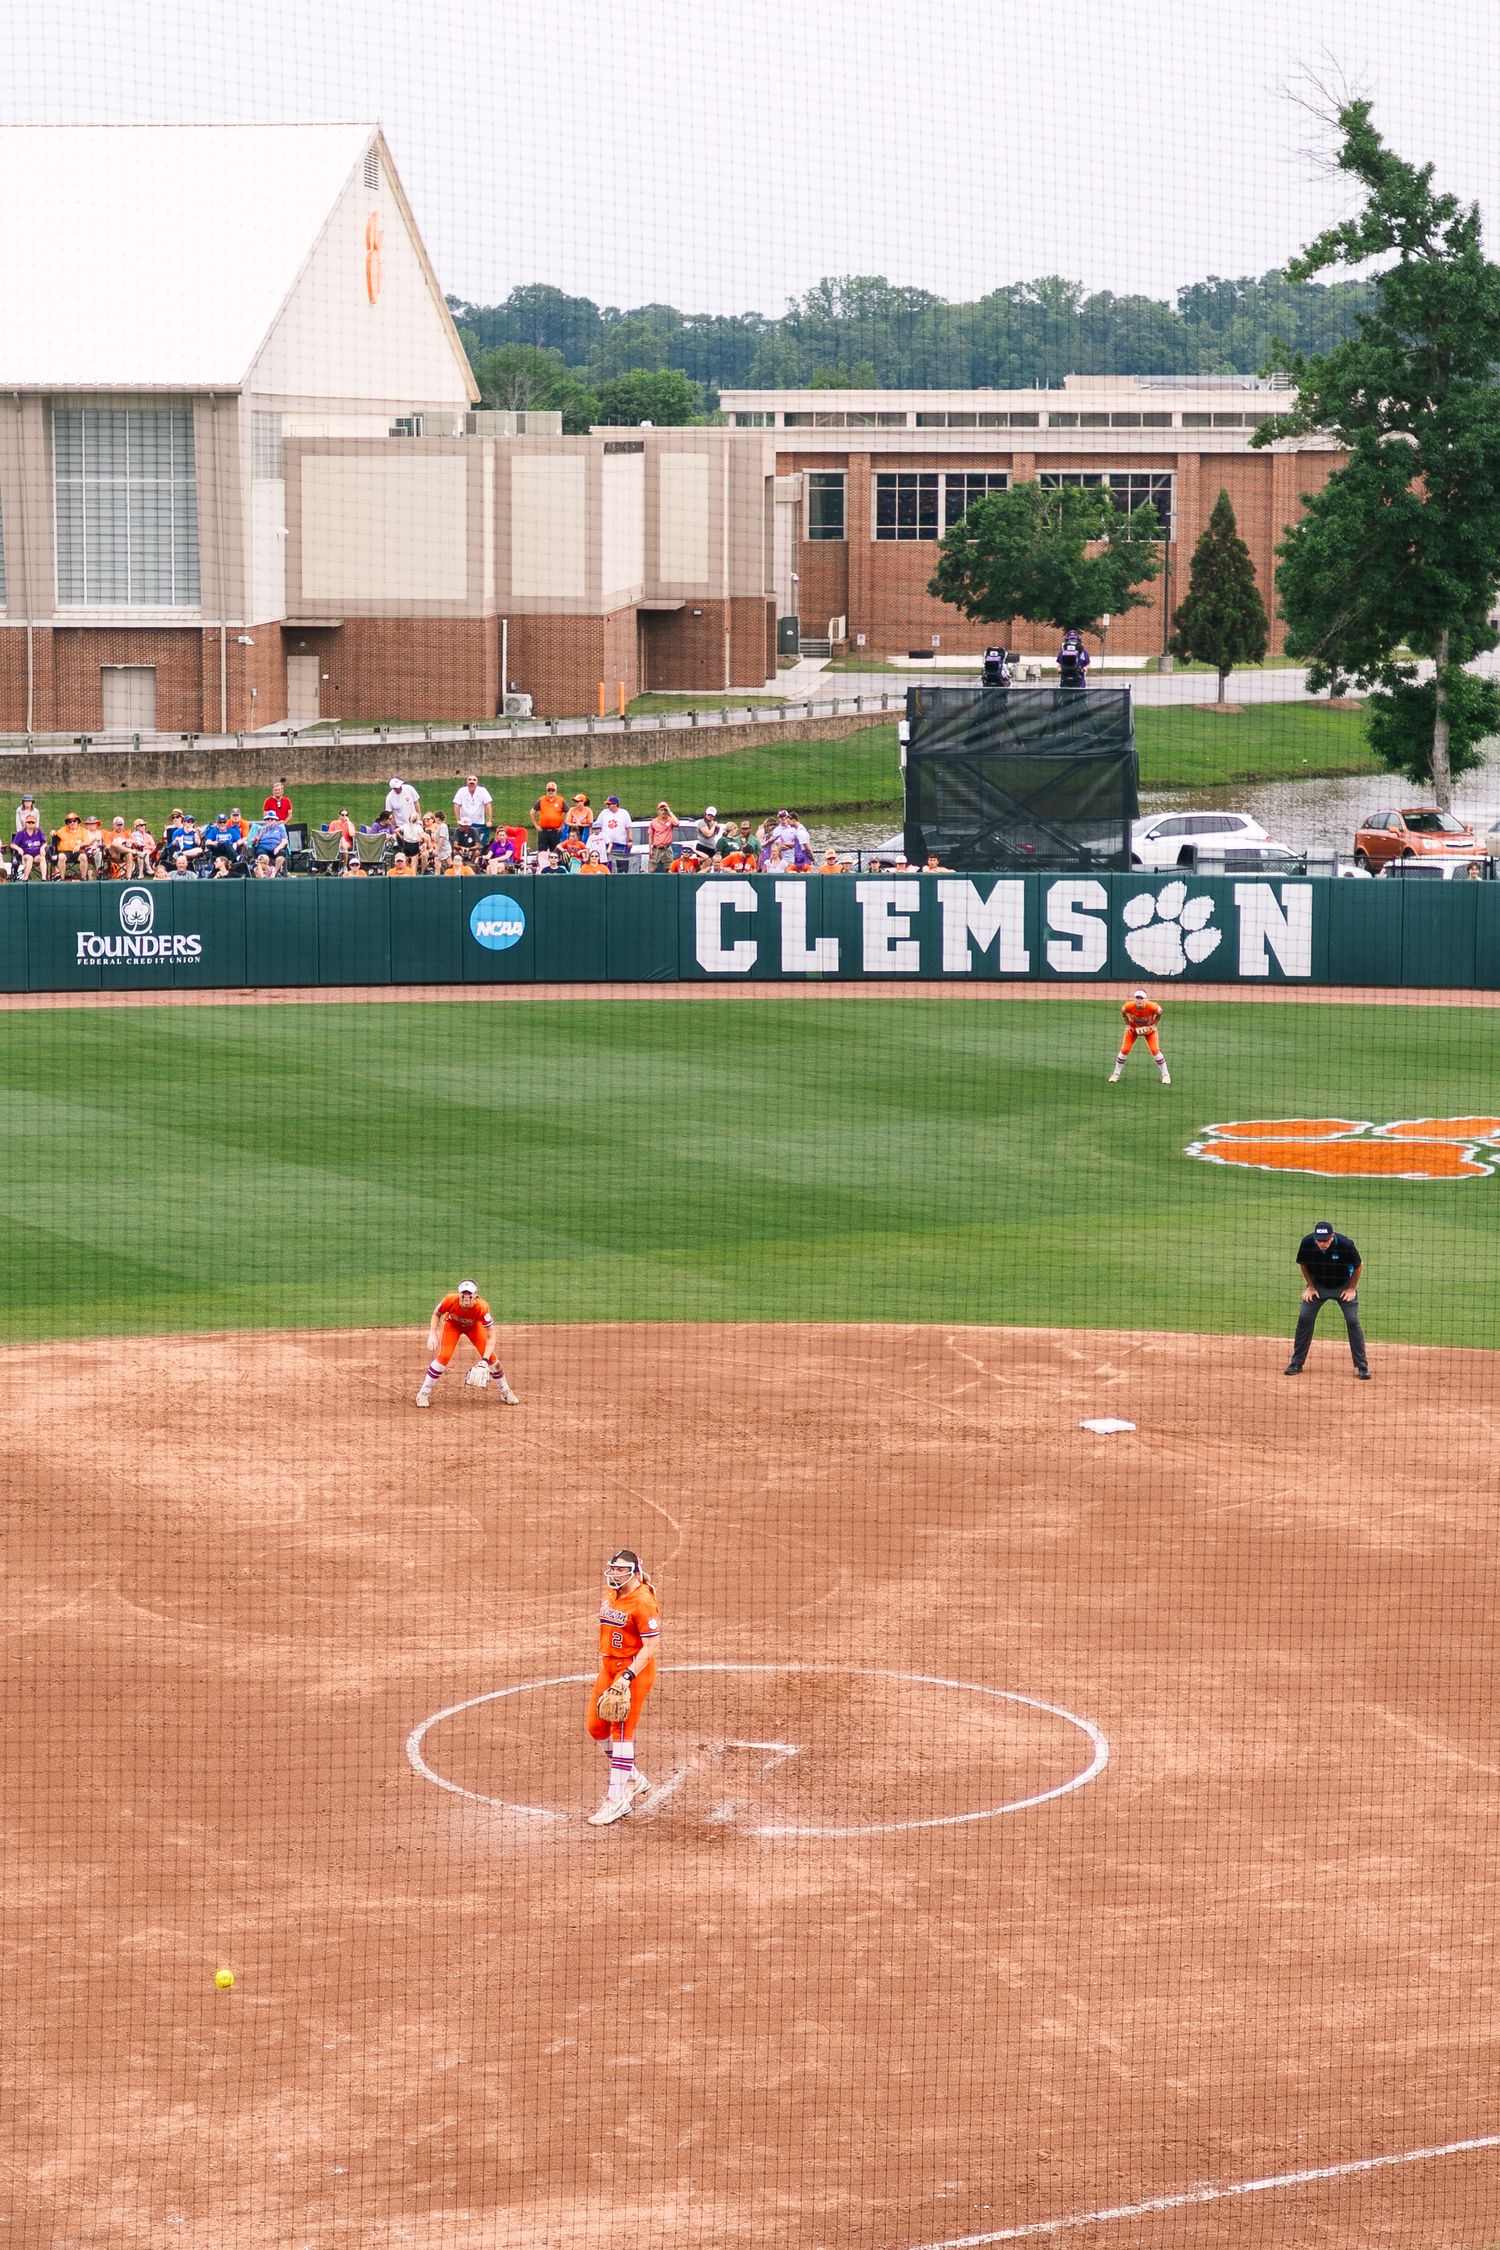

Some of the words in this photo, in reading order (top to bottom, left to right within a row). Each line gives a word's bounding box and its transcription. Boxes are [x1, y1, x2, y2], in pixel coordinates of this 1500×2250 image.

[475, 921, 523, 937] NCAA
[695, 879, 1313, 977] CLEMSN
[76, 931, 203, 957] FOUNDERS
[126, 957, 165, 965] CREDIT
[169, 956, 200, 964] UNION
[612, 1632, 622, 1648] 2
